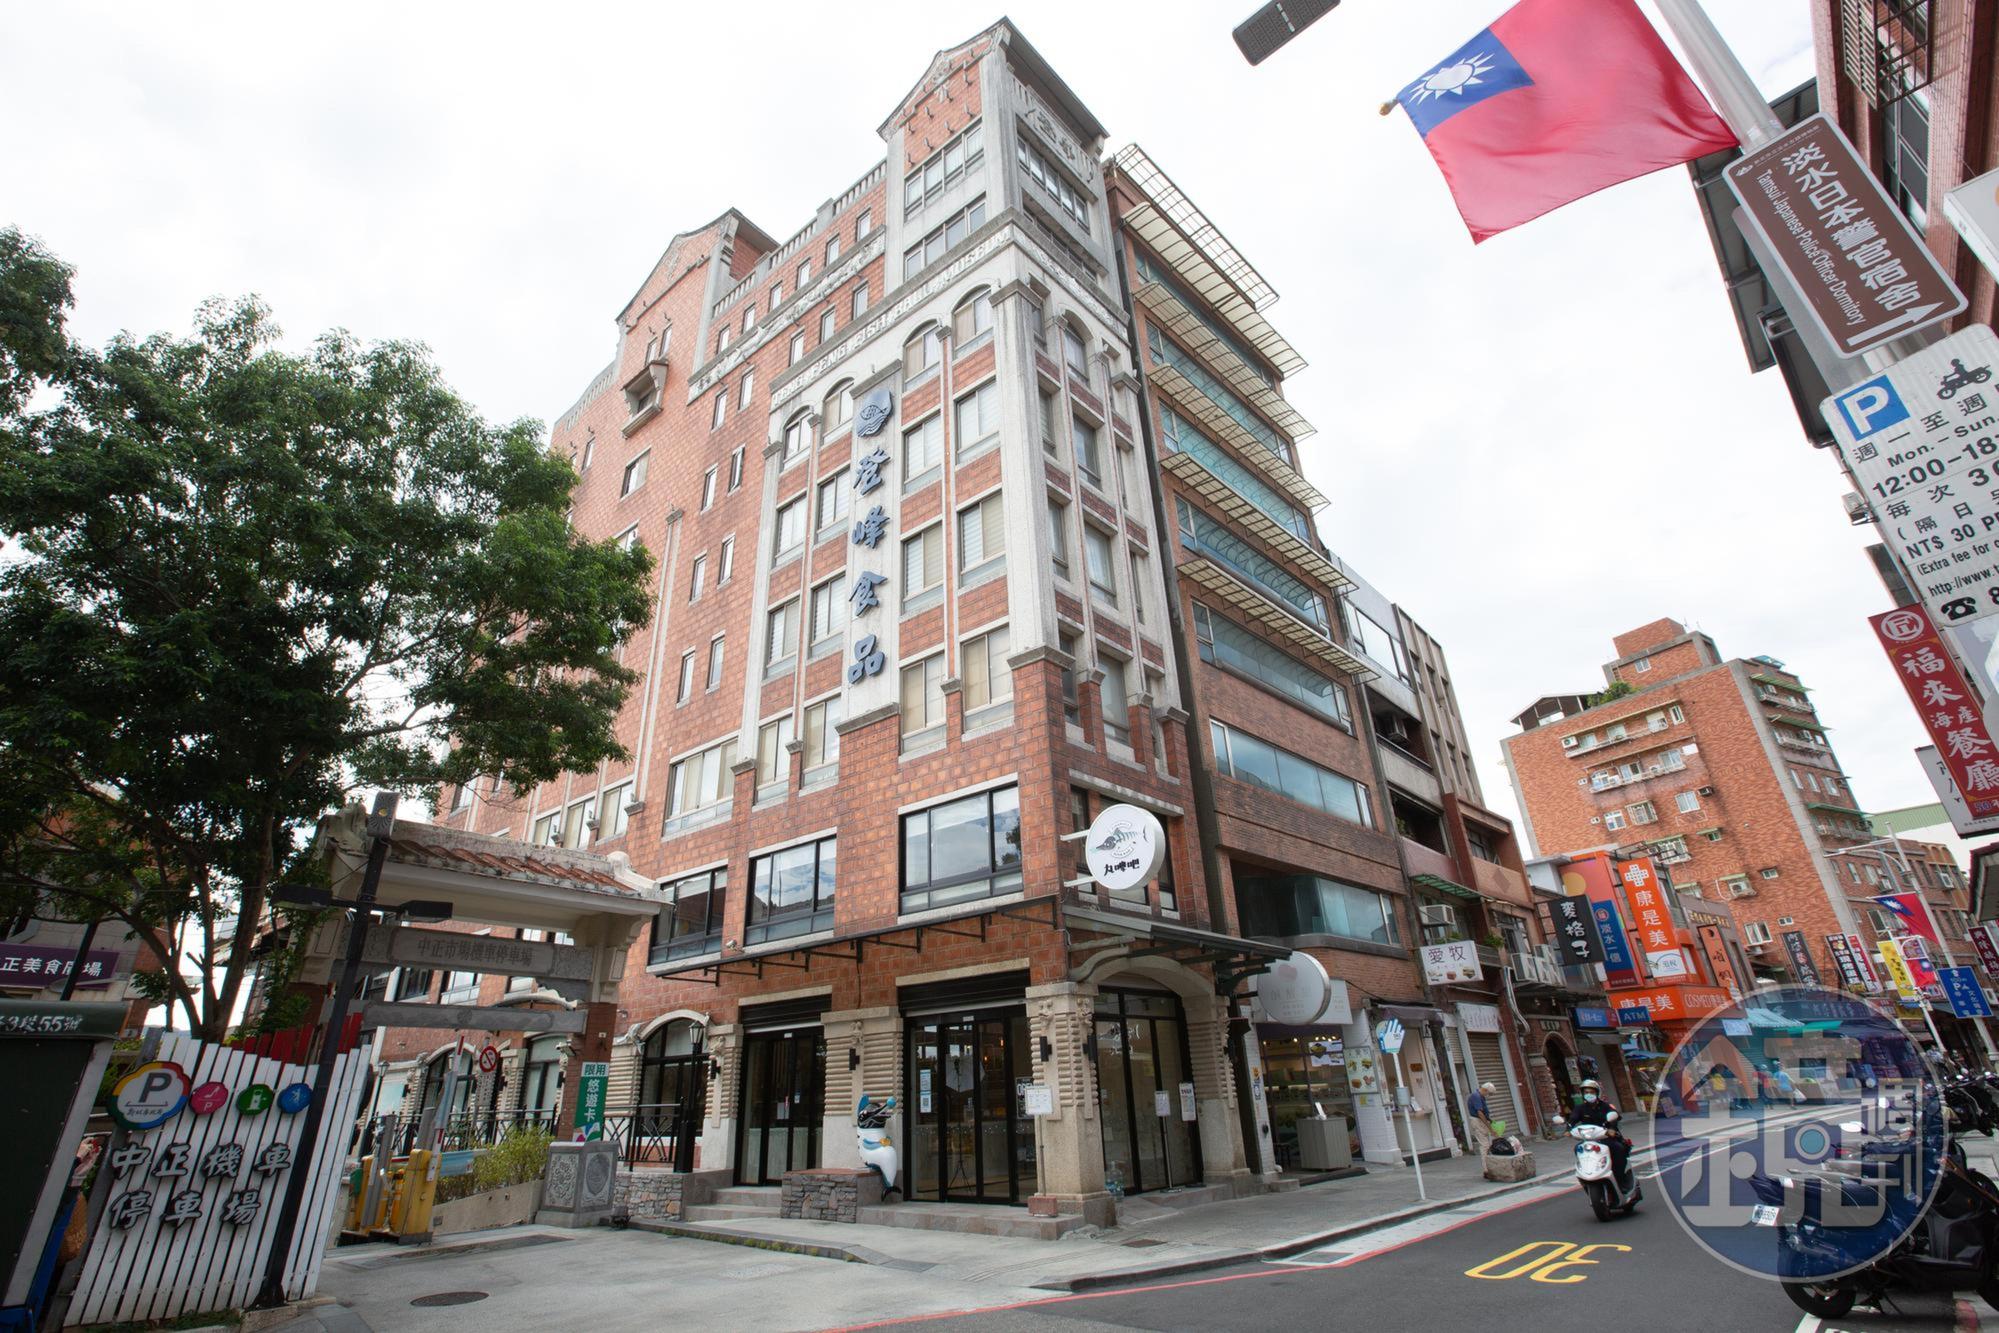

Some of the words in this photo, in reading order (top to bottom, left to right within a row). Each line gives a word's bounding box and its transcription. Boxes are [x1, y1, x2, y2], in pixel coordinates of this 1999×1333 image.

[1757, 169, 1785, 202] Tamsui
[1773, 197, 1804, 240] Japanese
[1800, 230, 1822, 259] Police
[1812, 252, 1839, 289] Officer
[1829, 280, 1866, 326] Dormitory
[1781, 142, 1921, 311] 淡水日本警官宿舍
[1843, 386, 1889, 435] P
[1853, 384, 1999, 463] 週一至週
[1887, 444, 1934, 468] Mon.
[1954, 415, 1999, 437] Sun.
[1906, 535, 1944, 560] NT$
[1950, 524, 1976, 542] 30
[1917, 558, 1949, 576] (Extra
[1952, 549, 1971, 564] fee
[1973, 541, 1990, 556] for
[848, 447, 891, 685] 登峰食品
[1560, 900, 1590, 959] 麥格子
[1635, 890, 1668, 948] 康是美
[1428, 945, 1467, 965] 愛牧
[1620, 993, 1675, 1013] 康是美
[1623, 1011, 1646, 1021] ATM
[139, 1073, 173, 1103] P
[584, 1064, 606, 1075] 限用
[583, 1079, 600, 1122] 悠遊卡
[111, 1142, 291, 1179] 中正機車
[110, 1189, 261, 1230] 停車場
